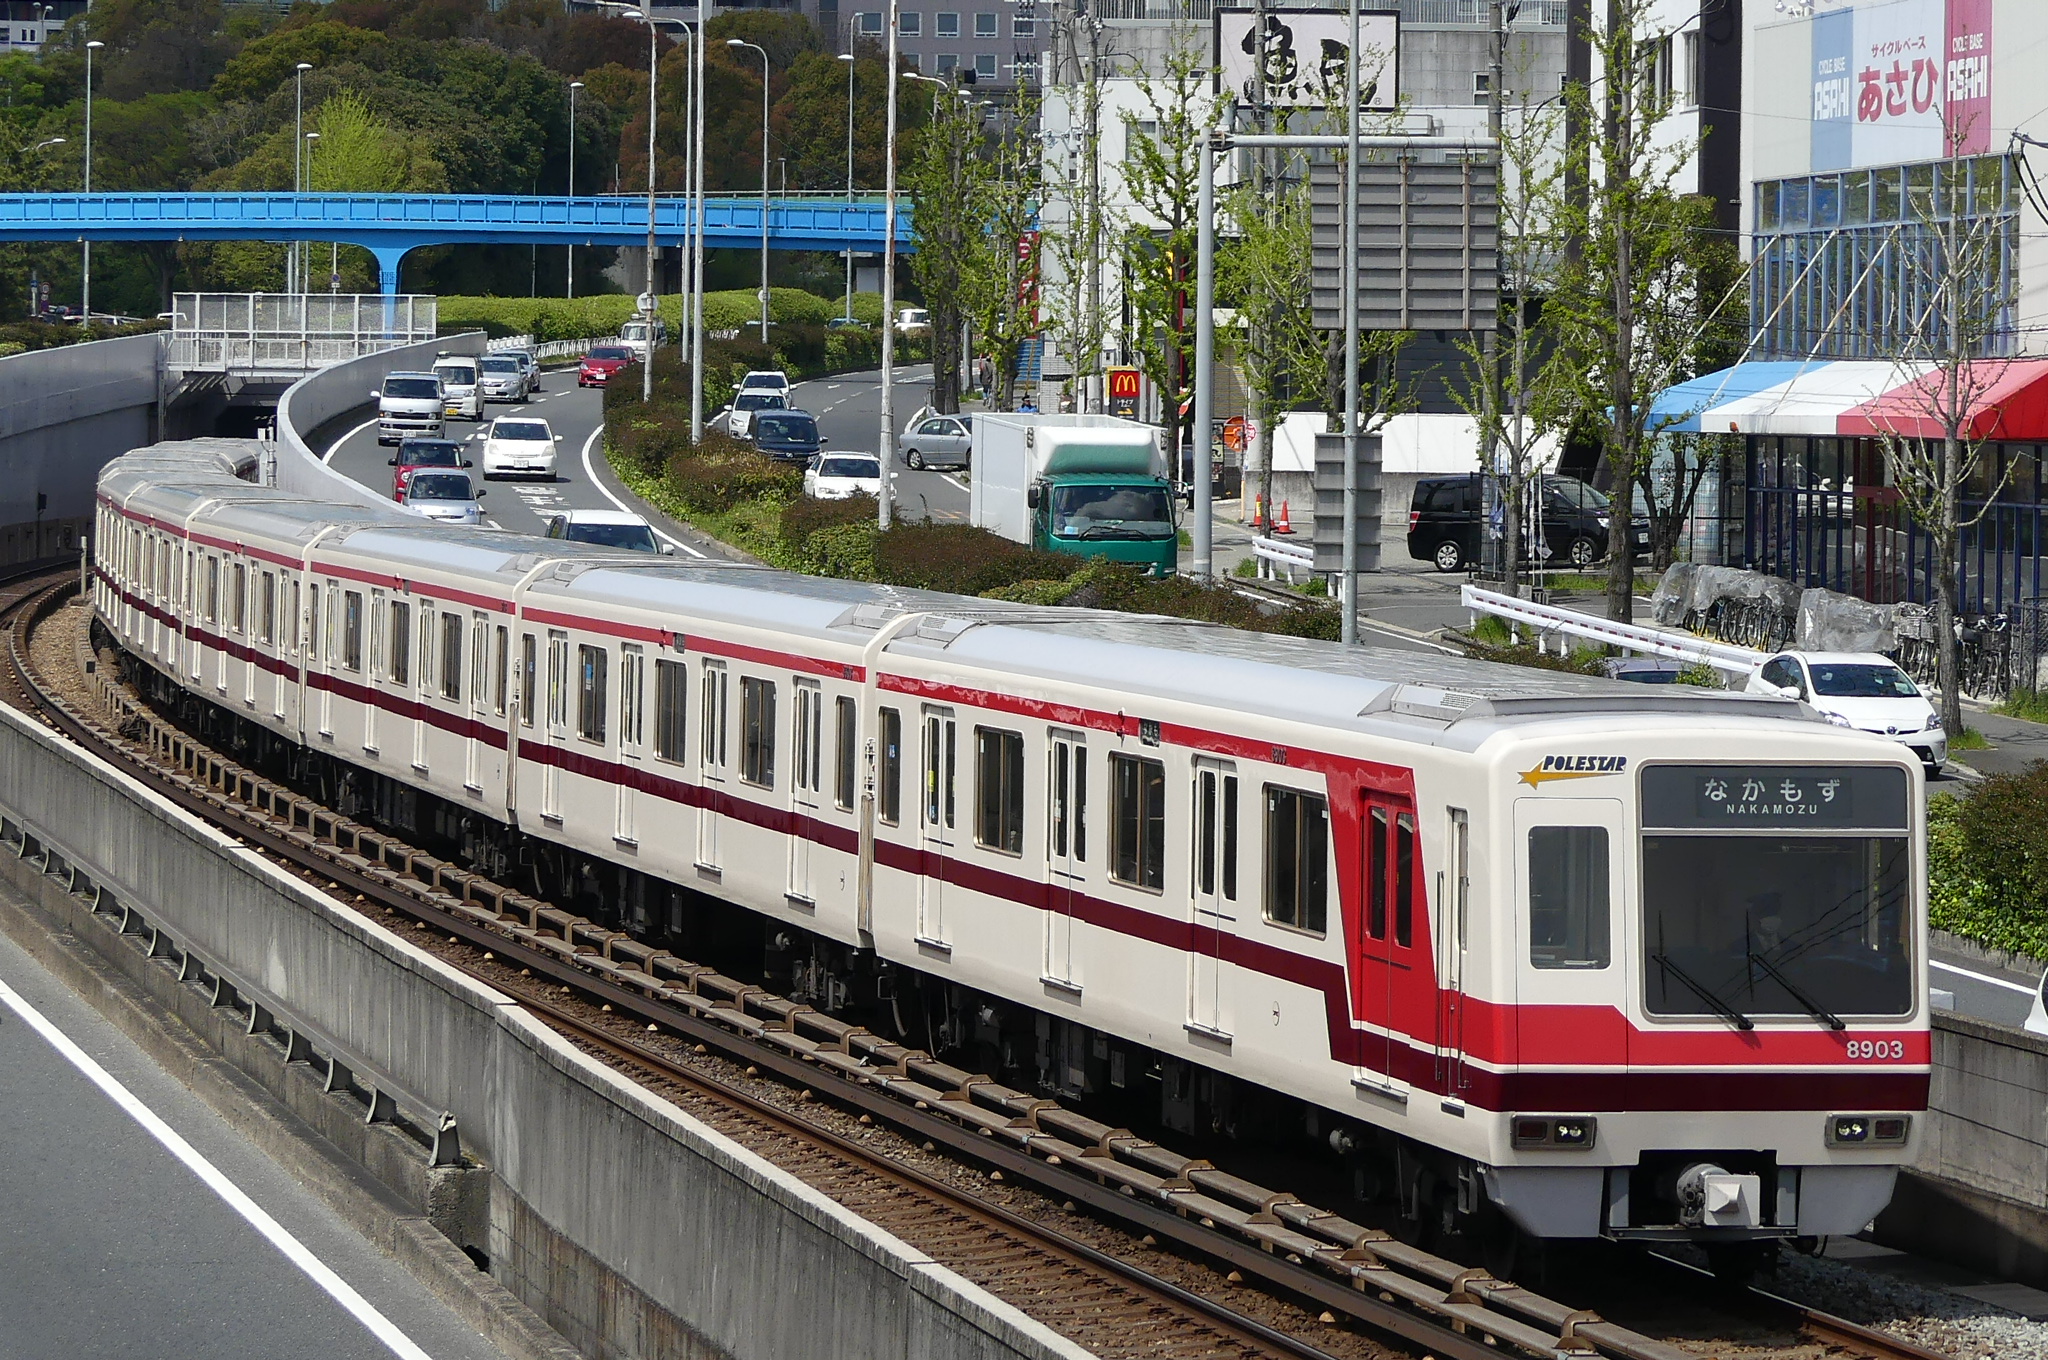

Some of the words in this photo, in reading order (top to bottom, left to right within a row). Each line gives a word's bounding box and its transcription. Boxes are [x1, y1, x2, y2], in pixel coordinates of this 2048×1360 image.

[1871, 35, 1927, 58] サイクルベース
[1969, 32, 1984, 50] BASE
[1857, 57, 1940, 122] あさひ
[1946, 55, 1988, 102] ASAHI
[1813, 77, 1850, 121] ASAHI
[1542, 755, 1628, 771] POLESTAR
[1704, 778, 1841, 803] なかもず
[1726, 804, 1818, 815] NAKAMOZU
[1845, 1039, 1905, 1060] 8903
